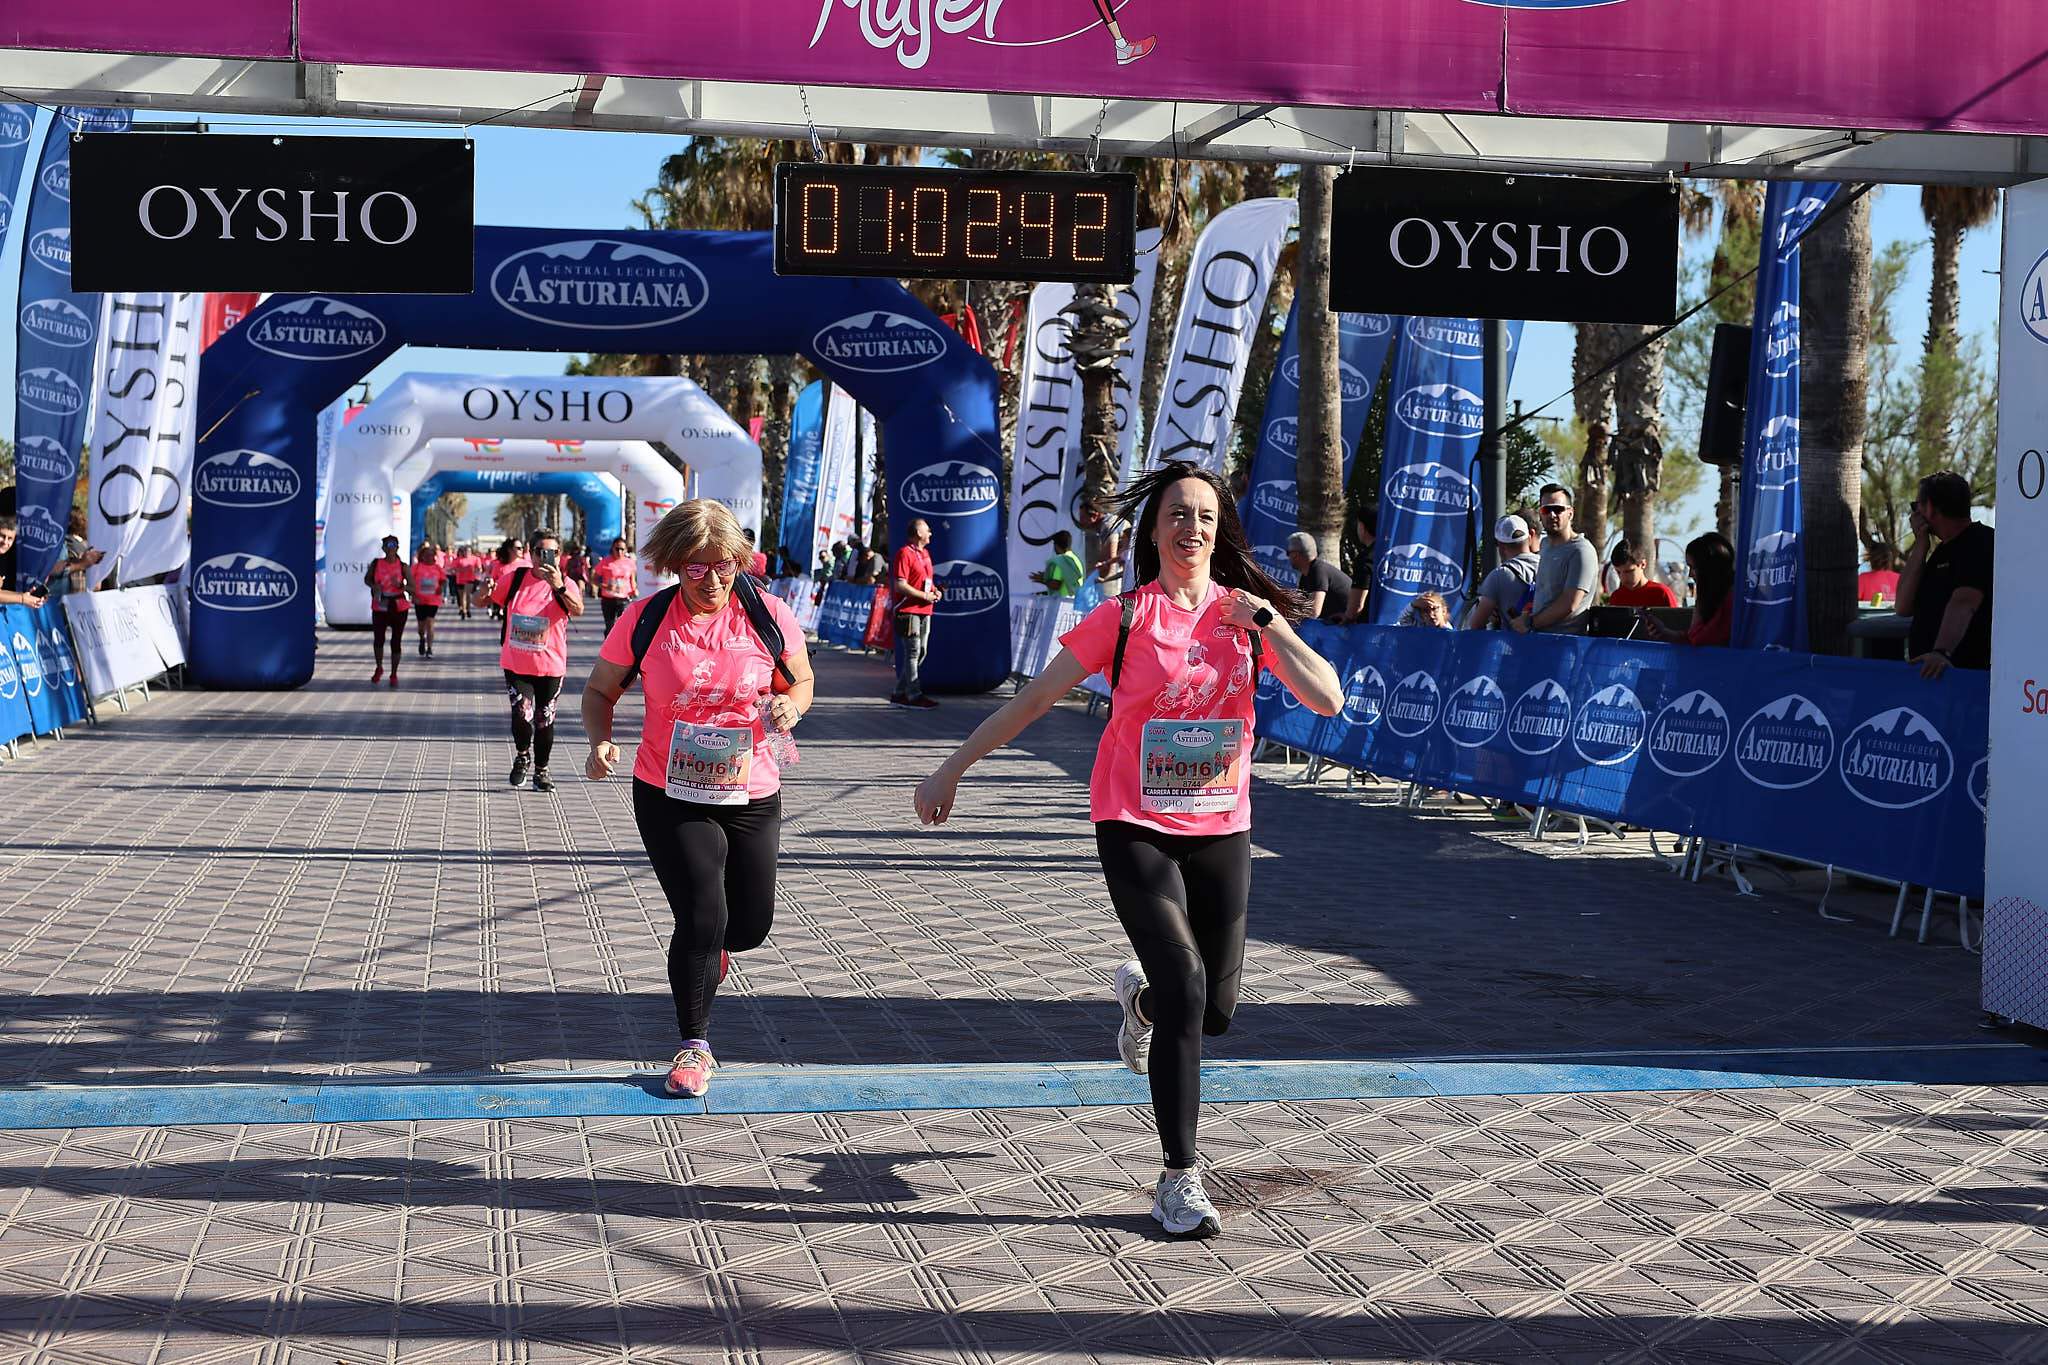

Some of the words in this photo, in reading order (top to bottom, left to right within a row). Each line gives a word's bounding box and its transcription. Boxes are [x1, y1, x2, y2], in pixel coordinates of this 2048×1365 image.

[138, 184, 418, 245] OYSHO
[35, 238, 71, 264] ASTUR
[1389, 217, 1629, 276] OYSHO
[541, 264, 608, 275] CENTRAL
[616, 267, 685, 278] LECHERA
[507, 265, 693, 307] ASTURIANA
[26, 309, 88, 341] ASTURIANA
[255, 320, 375, 345] ASTURIANA
[1414, 321, 1484, 348] ASTURIA
[825, 336, 938, 358] ASTURIANA
[1160, 251, 1259, 462] YSHO
[98, 297, 165, 526] OYSH
[463, 387, 634, 424] OYSHO
[1402, 399, 1484, 429] ASTURIANA
[358, 424, 411, 436] OYSHO
[200, 471, 293, 494] ASTURIANA
[907, 483, 996, 503] ASTURIANA
[1391, 481, 1470, 509] ASTURIANA
[335, 492, 383, 504] OYSHO
[333, 563, 370, 574] OYSH
[1383, 560, 1455, 589] ASTURIANA
[198, 574, 290, 598] ASTURIANA
[943, 584, 1000, 601] URIANA
[1387, 692, 1433, 723] ASTURIANA
[1449, 699, 1499, 731] ASTURIANA
[1511, 706, 1564, 737] ASTURIANA
[1576, 712, 1638, 748] ASTURIANA
[1175, 734, 1213, 743] ASTURIANA
[1652, 719, 1721, 757] ASTURIANA
[1740, 725, 1825, 769] ASTURIANA
[694, 760, 726, 775] 016
[1175, 761, 1211, 777] 016
[1846, 738, 1938, 789] ASTURIANA
[673, 787, 699, 798] OYSHO
[1146, 788, 1171, 796] CARRERA
[1151, 799, 1183, 808] OYSHO
